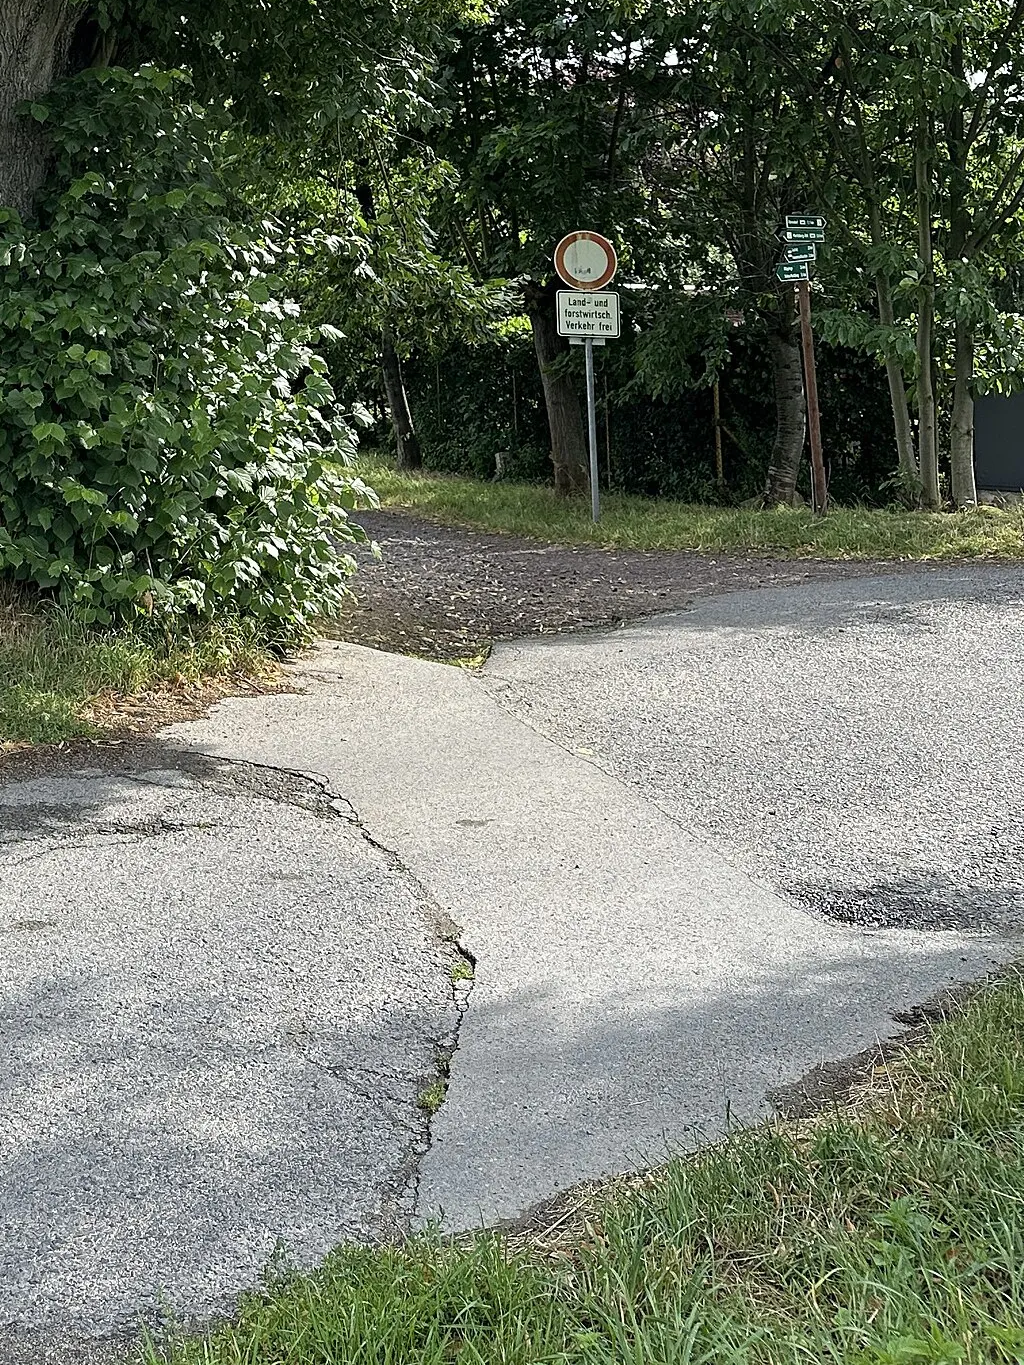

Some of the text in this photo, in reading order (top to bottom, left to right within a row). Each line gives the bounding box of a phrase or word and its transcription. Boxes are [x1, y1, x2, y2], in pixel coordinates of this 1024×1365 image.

[568, 297, 608, 307] Land- und
[564, 308, 613, 319] forstwirtsch.
[565, 321, 613, 331] Verkehr frei
